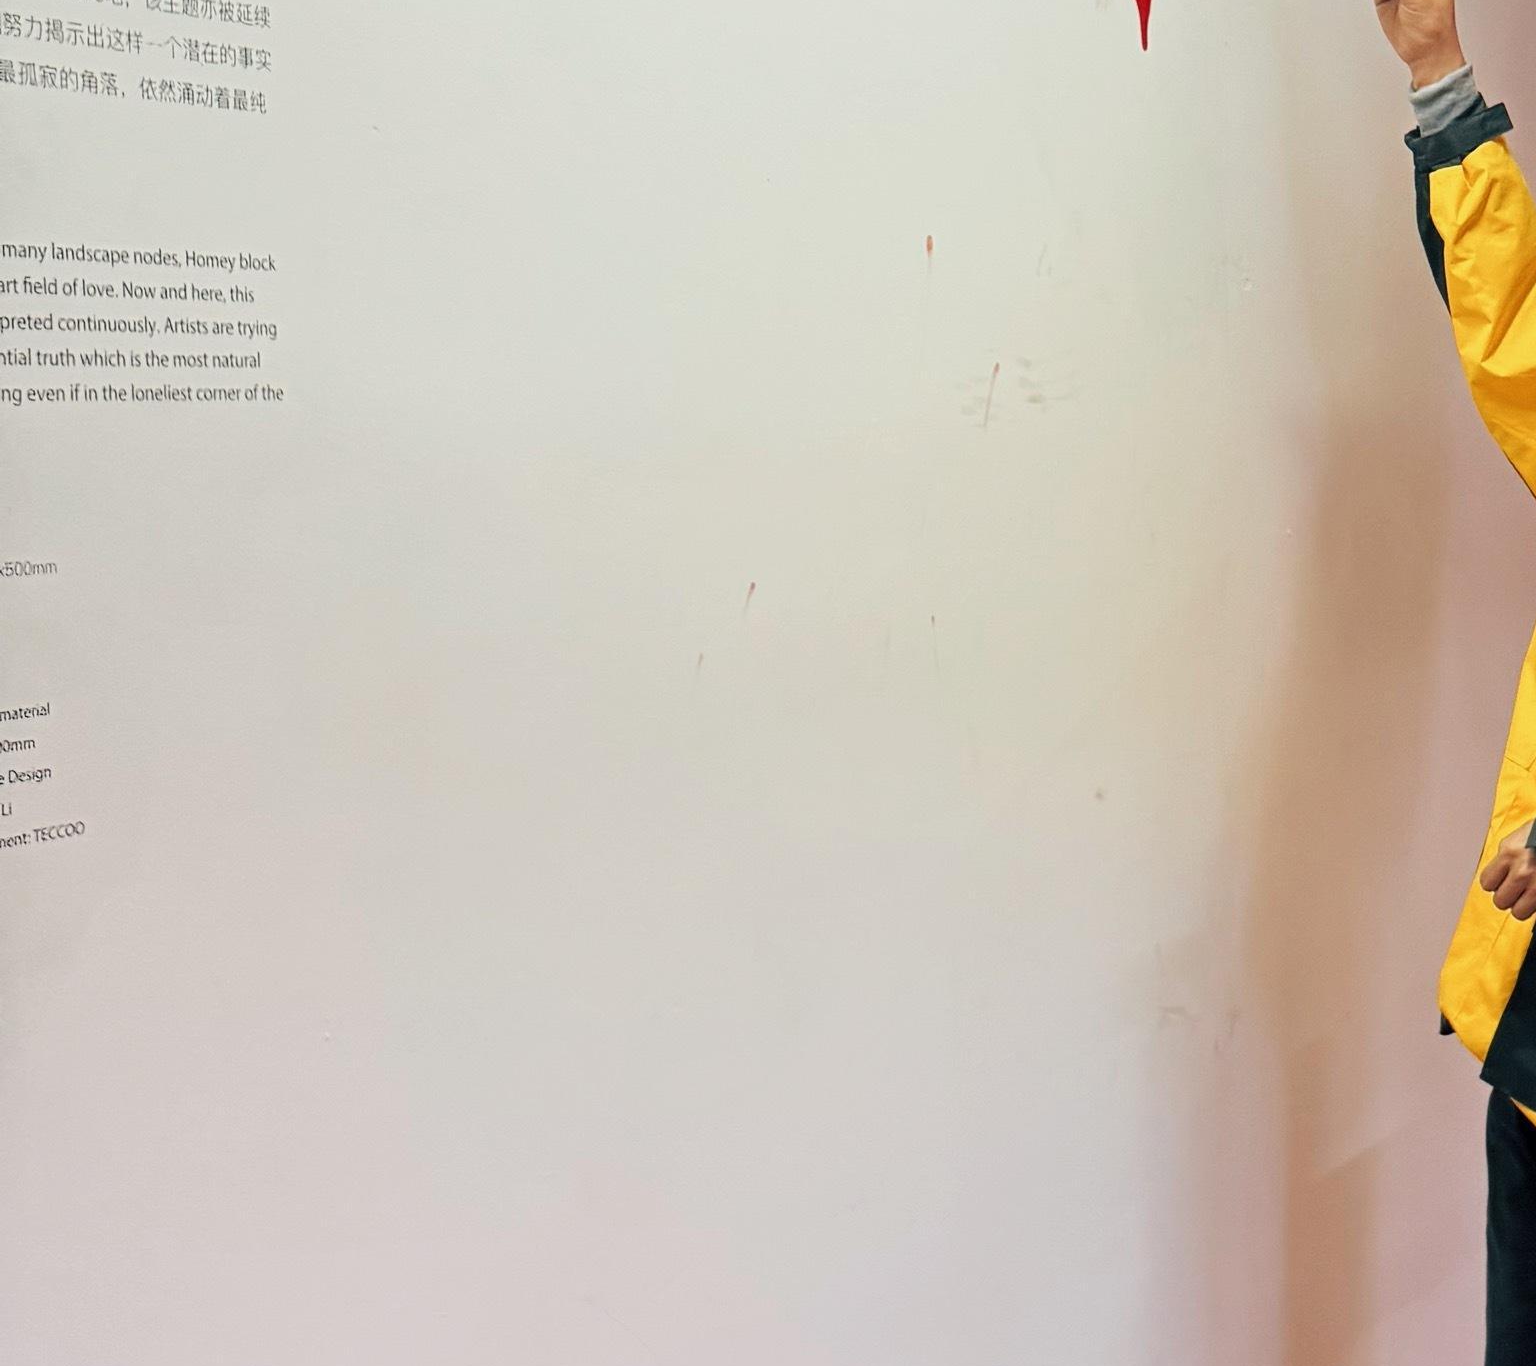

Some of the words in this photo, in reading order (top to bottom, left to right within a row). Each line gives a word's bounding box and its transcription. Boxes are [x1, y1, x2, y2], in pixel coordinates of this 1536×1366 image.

[1, 244, 47, 263] many
[51, 242, 129, 267] landscape
[133, 248, 182, 268] nodes,
[185, 251, 236, 273] Homey
[239, 253, 276, 271] block
[23, 276, 57, 295] field
[62, 278, 78, 296] of
[82, 279, 118, 298] love.
[122, 281, 156, 299] Now
[160, 283, 187, 301] and
[191, 283, 226, 303] here,
[230, 285, 254, 303] this
[0, 313, 53, 334] preted
[57, 315, 160, 338] continuously.
[164, 317, 208, 335] Artists
[212, 322, 234, 336] are
[238, 320, 277, 340] trying
[37, 348, 75, 367] truth
[80, 349, 126, 367] which
[131, 350, 141, 367] is
[145, 350, 169, 368] the
[173, 352, 208, 368] most
[212, 351, 260, 368] natural
[1, 388, 22, 406] ng
[27, 388, 65, 402] even
[70, 383, 80, 401] if
[84, 385, 98, 401] in
[102, 384, 127, 402] the
[131, 383, 192, 401] loneliest
[196, 387, 241, 402] corner
[244, 383, 259, 401] of
[262, 385, 284, 401] the
[8, 768, 52, 783] Design
